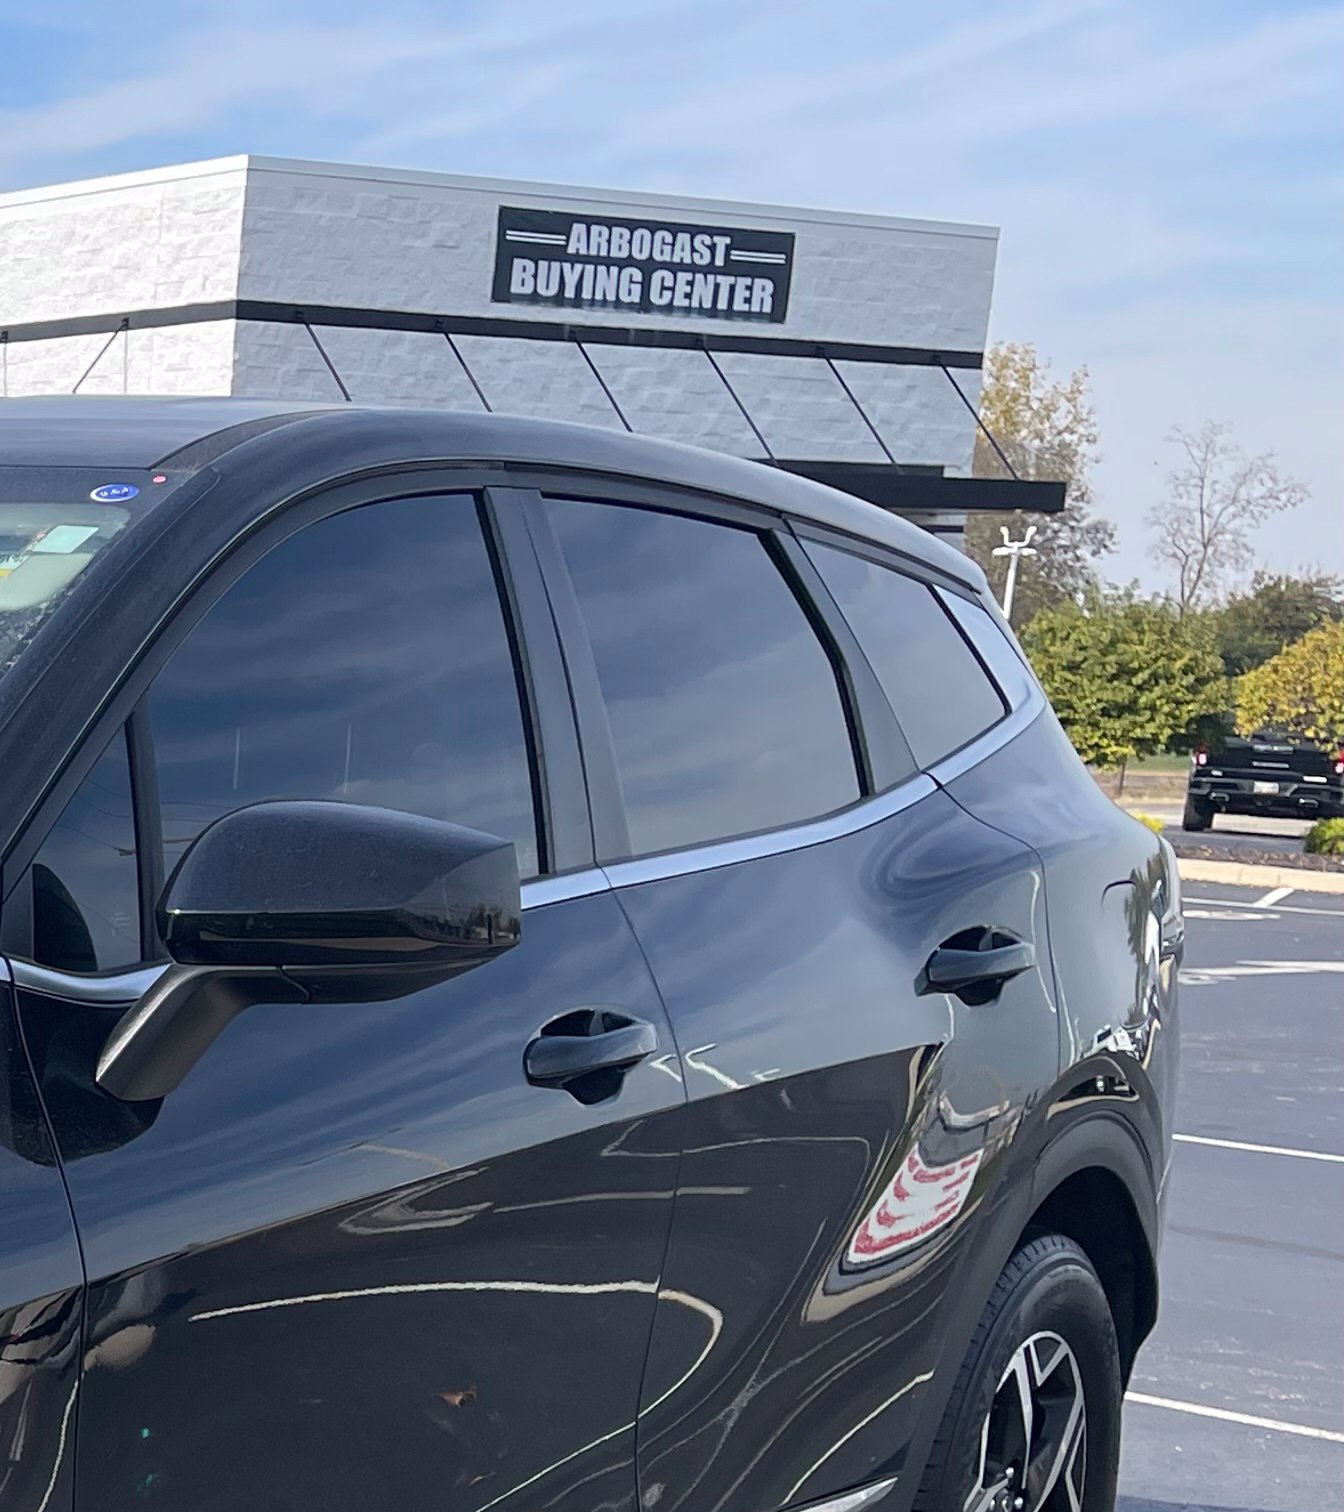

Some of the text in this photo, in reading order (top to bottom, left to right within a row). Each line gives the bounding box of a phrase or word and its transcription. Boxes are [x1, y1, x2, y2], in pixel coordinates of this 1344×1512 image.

[566, 222, 732, 268] ARBOGAST
[509, 257, 775, 314] BUYING CENTER
